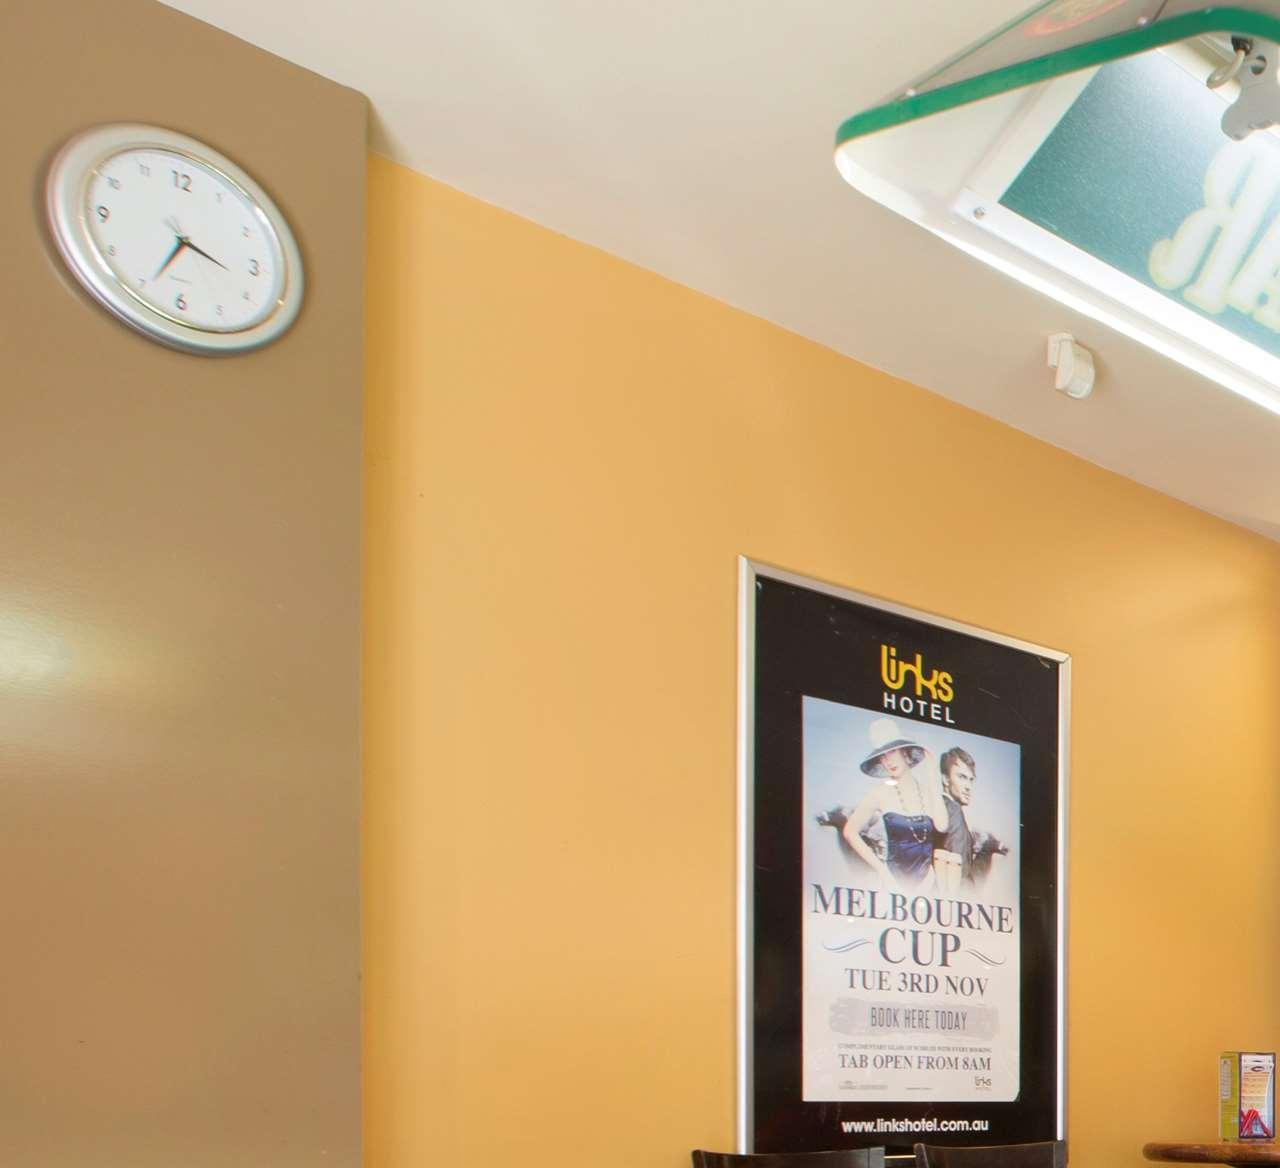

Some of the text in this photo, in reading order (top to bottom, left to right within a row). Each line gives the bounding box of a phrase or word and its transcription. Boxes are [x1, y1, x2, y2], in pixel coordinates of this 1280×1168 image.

[171, 169, 193, 193] 12
[96, 204, 111, 223] 9
[248, 258, 261, 277] 3
[174, 293, 188, 311] 6
[881, 644, 954, 703] links
[883, 692, 956, 724] HOTEL
[811, 884, 1014, 934] MELBOURNE
[879, 927, 961, 968] CUP
[845, 968, 989, 998] TUE 3RD NOV
[871, 1007, 968, 1031] BOOK HERE TODAY
[838, 1054, 992, 1071] TAB OPEN FROM 8AM
[842, 1118, 990, 1134] www.linkshotel.com.au
